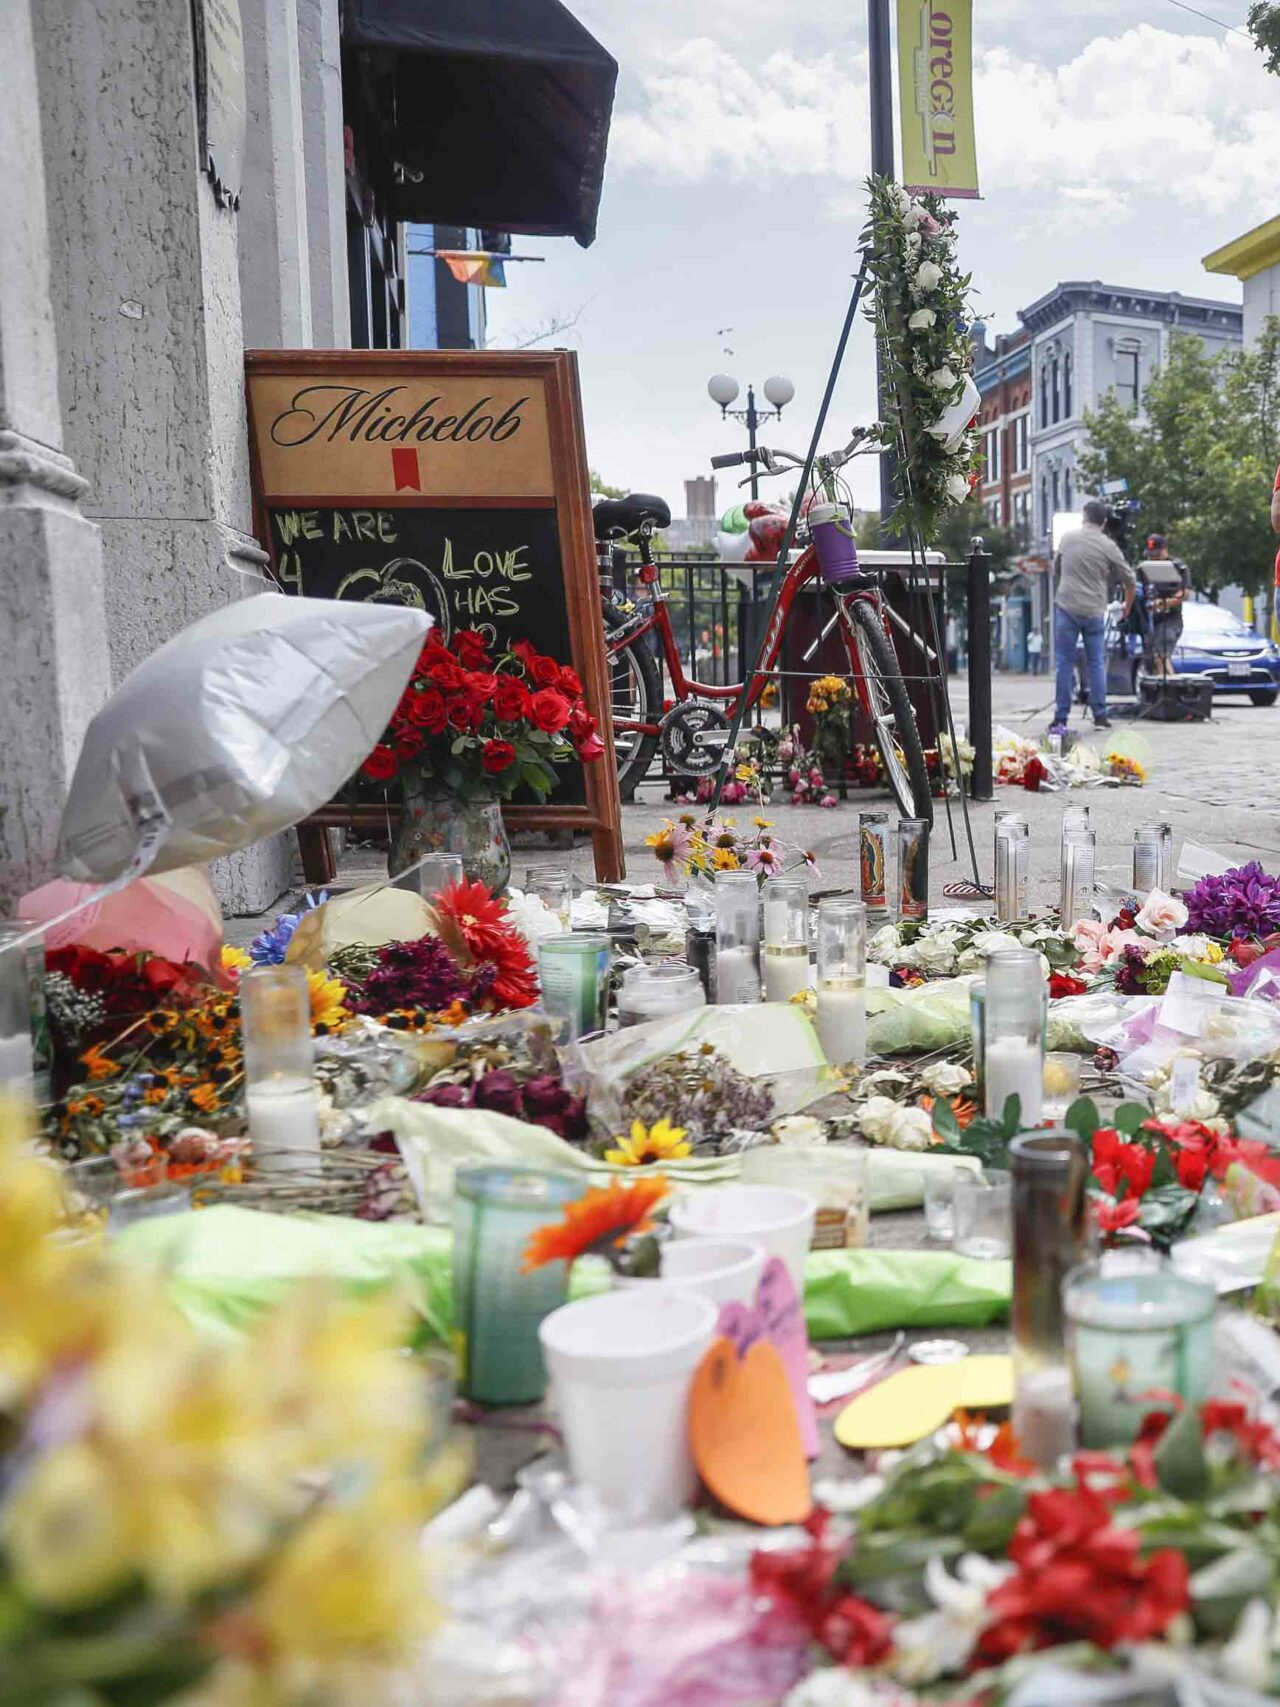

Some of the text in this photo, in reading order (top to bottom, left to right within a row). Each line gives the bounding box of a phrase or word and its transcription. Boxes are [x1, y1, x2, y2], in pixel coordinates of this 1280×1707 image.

[271, 385, 530, 446] Michelob
[275, 511, 397, 546] WE ARE
[442, 537, 533, 582] LOVE
[455, 586, 520, 617] HAS
